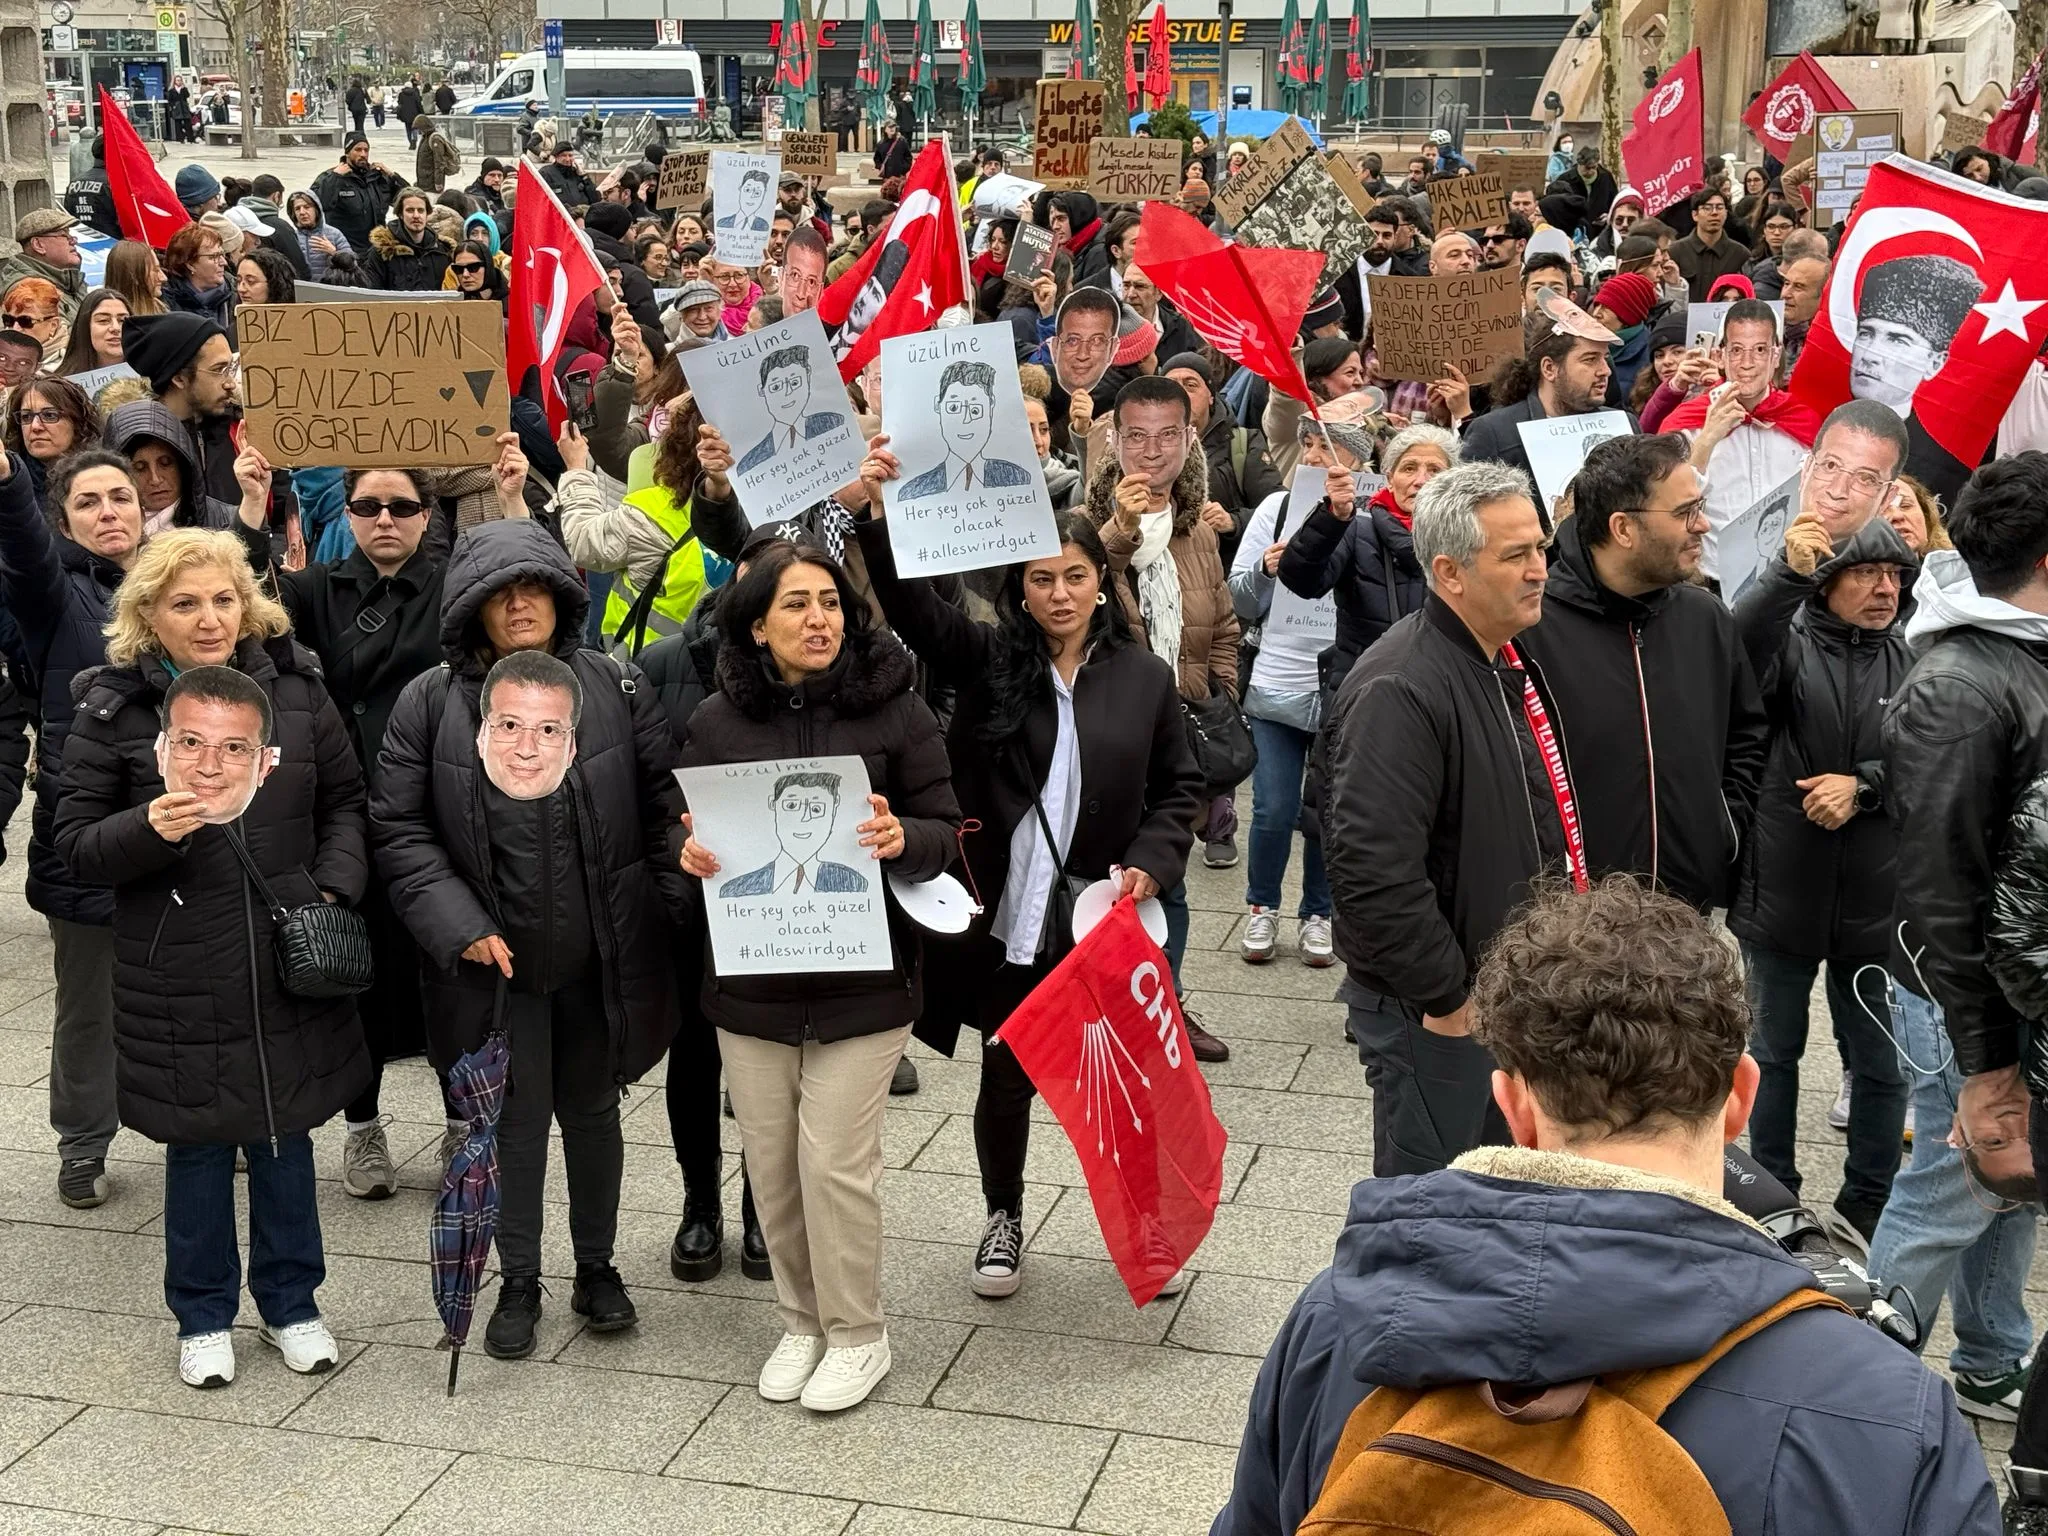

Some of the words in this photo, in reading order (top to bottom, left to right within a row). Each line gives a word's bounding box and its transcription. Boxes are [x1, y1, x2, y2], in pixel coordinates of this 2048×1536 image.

[1039, 84, 1103, 116] Liberté
[789, 144, 829, 154] SERBEST
[1098, 142, 1145, 160] Mesele
[663, 155, 684, 173] STOP
[727, 156, 768, 168] üzülme
[68, 180, 103, 194] POLIZEI
[661, 168, 698, 186] CRIMES
[1096, 172, 1176, 196] TÜRKİYE
[659, 188, 668, 200] IN
[671, 181, 707, 197] TURKEY
[1427, 183, 1459, 204] HAK
[1461, 175, 1504, 199] HUKUK
[1438, 197, 1505, 229] ADALET
[1394, 282, 1439, 301] DEFA
[239, 309, 292, 344] BIZ
[302, 308, 463, 360] DEVRIMI
[1375, 319, 1425, 340] YAPTIK
[717, 327, 792, 368] üzülme
[908, 333, 982, 364] üzülme
[1383, 337, 1403, 352] BU
[1408, 341, 1454, 357] SEFER
[1461, 337, 1484, 356] DE
[243, 365, 416, 410] DENIZ'DE
[1549, 419, 1608, 437] üzülme
[744, 470, 767, 490] Her
[769, 462, 789, 480] şey
[791, 446, 811, 467] çok
[817, 429, 851, 455] güzel
[786, 458, 827, 486] olacak
[765, 461, 856, 519] #alleswirdgut
[1356, 476, 1386, 491] lme
[905, 504, 930, 522] Her
[937, 505, 958, 520] şey
[965, 497, 989, 514] çok
[997, 490, 1038, 512] güzel
[953, 515, 1004, 534] olacak
[917, 531, 1038, 562] #alleswirdgut
[1314, 602, 1336, 614] olac
[725, 760, 823, 777] üzülme
[727, 903, 755, 919] Her
[761, 904, 784, 921] şey
[792, 900, 817, 916] çok
[827, 898, 872, 916] güzel
[778, 921, 833, 936] olacak
[738, 940, 868, 961] #alleswirdgut
[1130, 960, 1181, 1069] CHP
